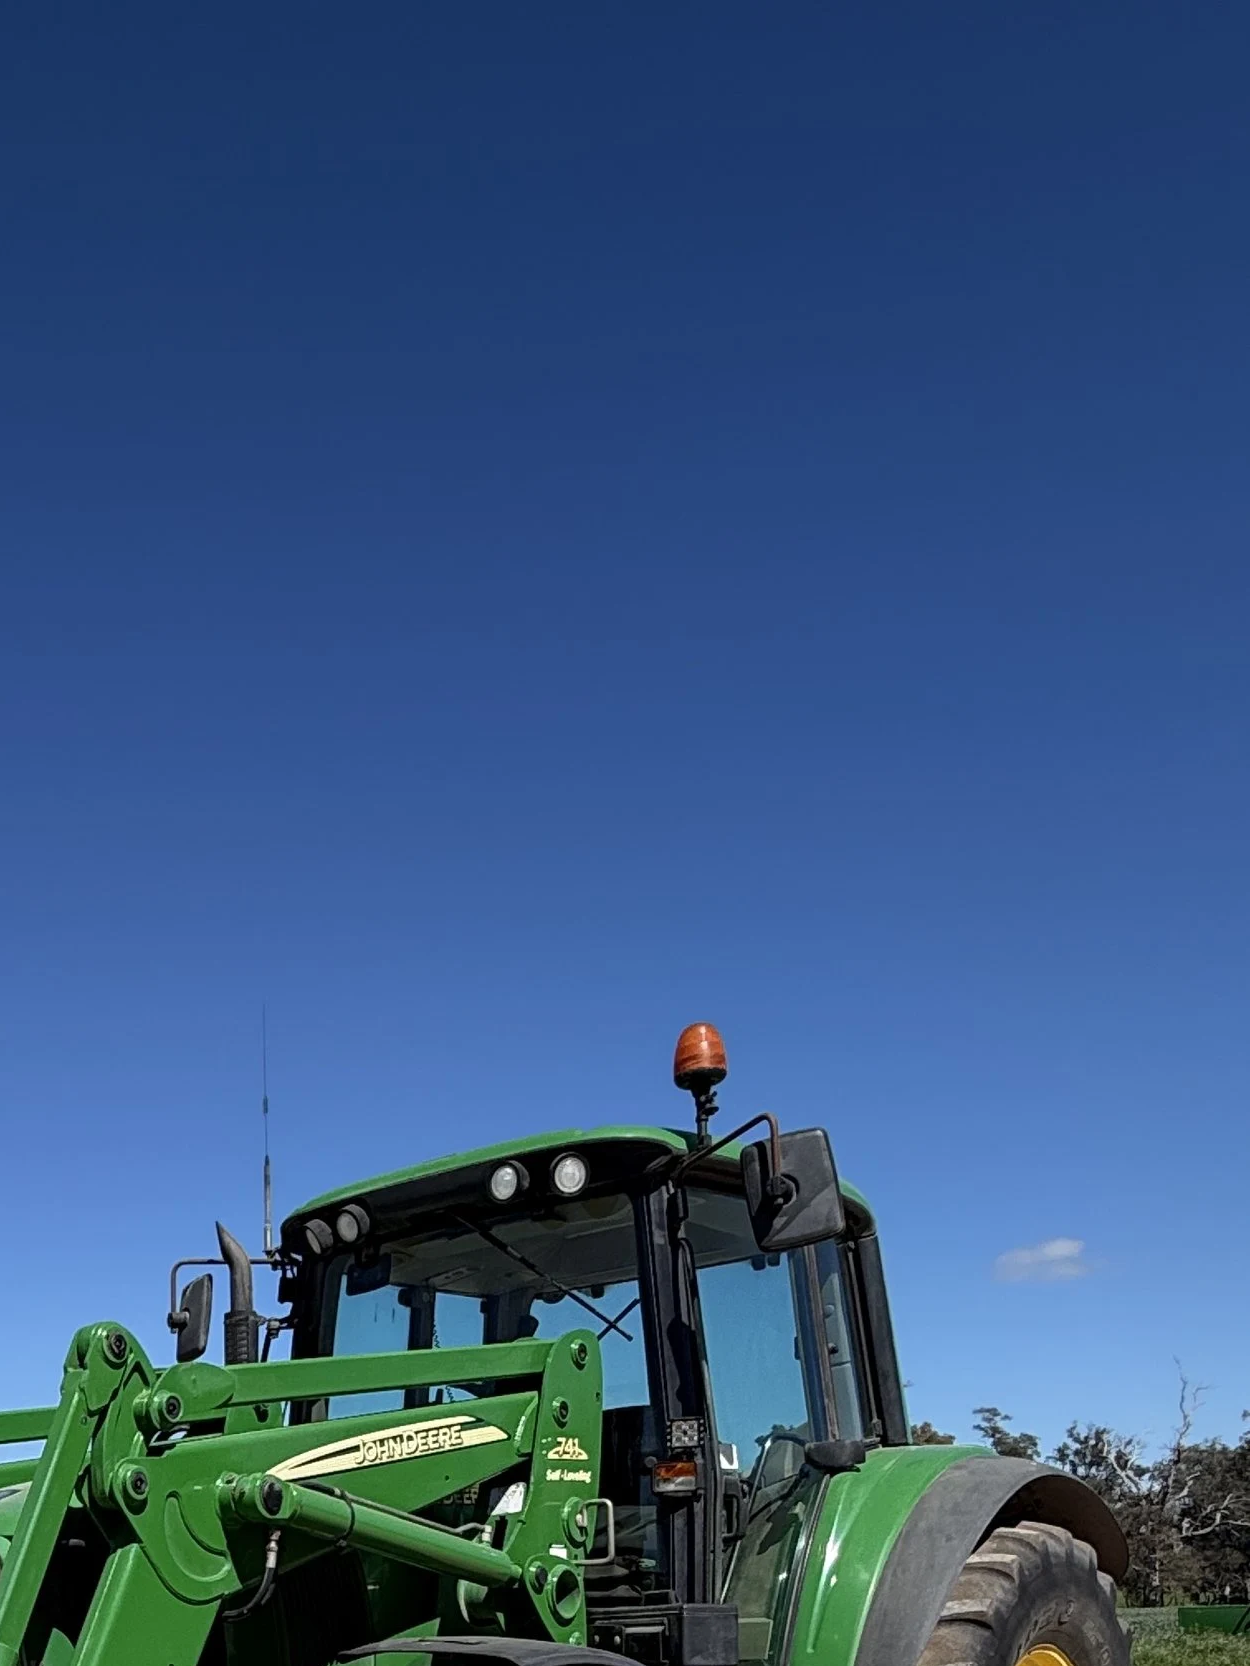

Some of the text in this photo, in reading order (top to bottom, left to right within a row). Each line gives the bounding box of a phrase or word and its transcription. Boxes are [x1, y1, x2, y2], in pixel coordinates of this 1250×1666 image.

[355, 1425, 464, 1465] JOHN DEERE
[557, 1436, 579, 1458] 741
